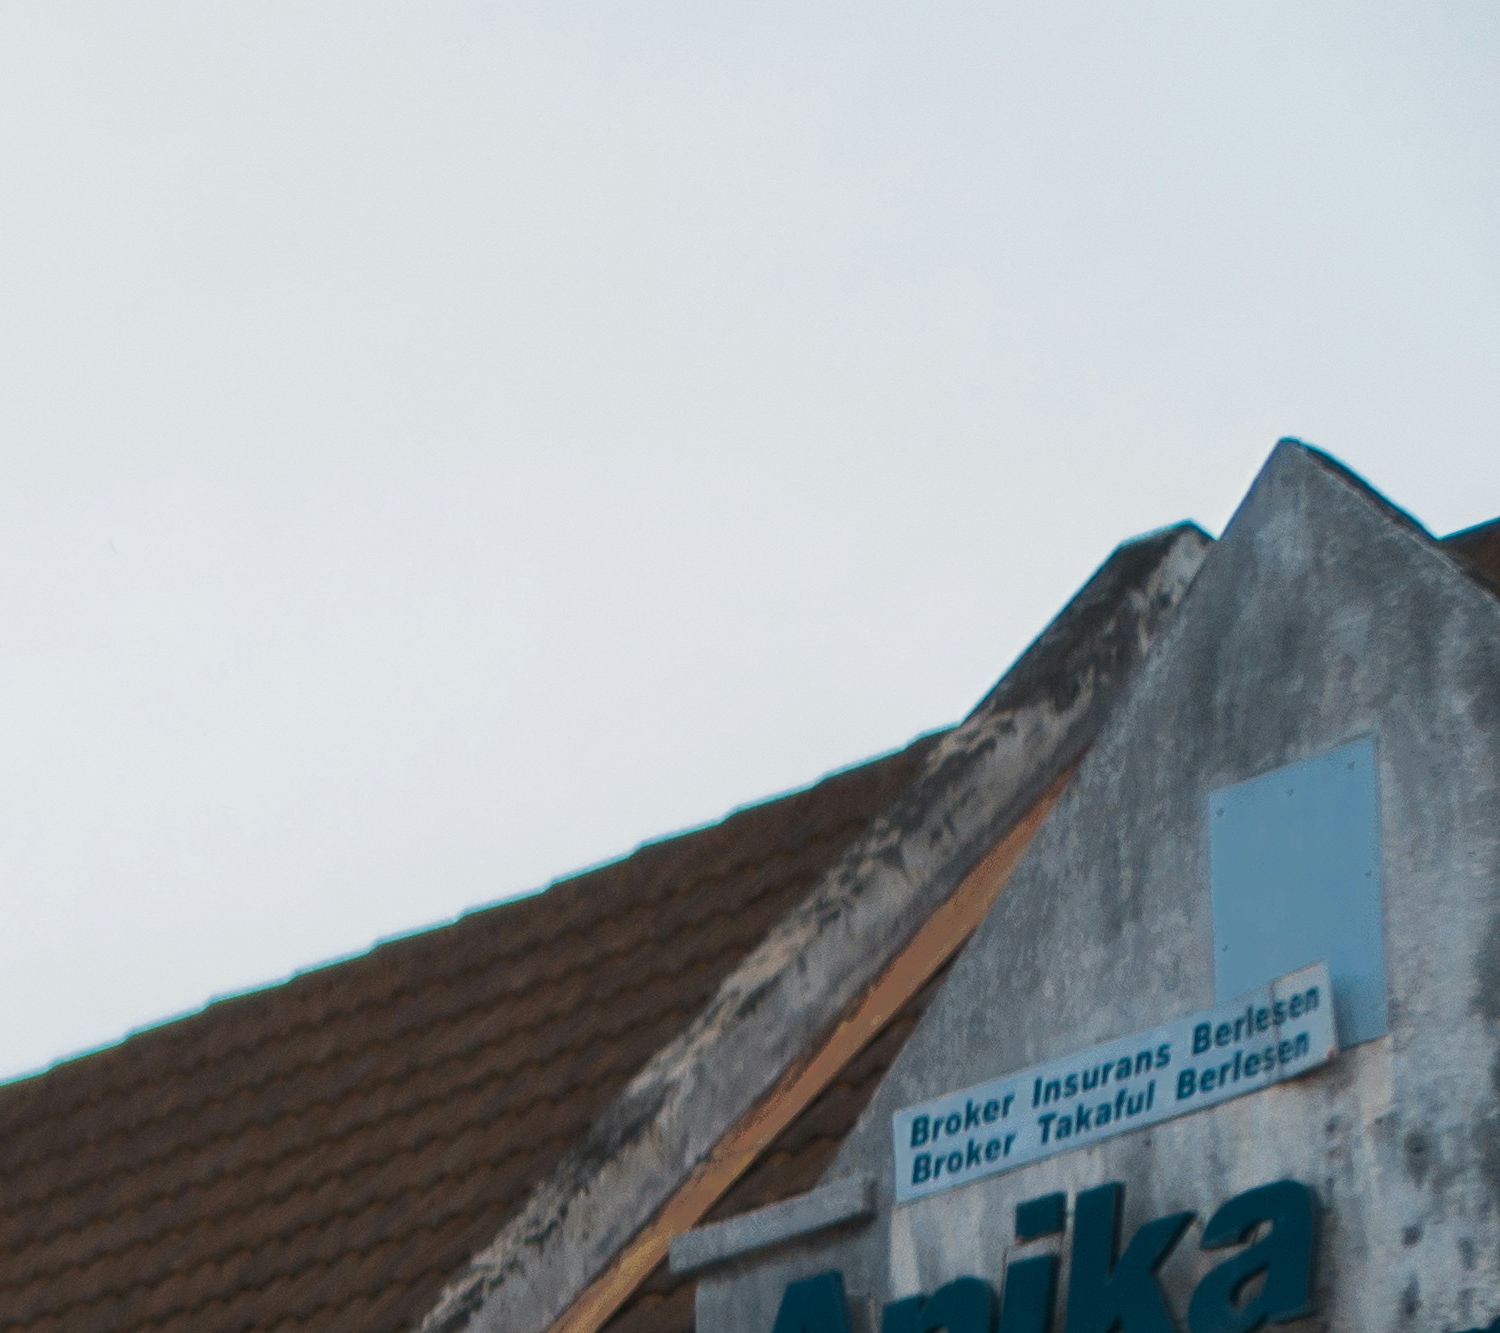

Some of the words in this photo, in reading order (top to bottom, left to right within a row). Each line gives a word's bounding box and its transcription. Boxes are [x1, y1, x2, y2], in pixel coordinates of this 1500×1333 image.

[910, 1089, 1014, 1147] Broker
[1032, 1043, 1172, 1107] Insurans
[1192, 985, 1320, 1056] Berlesen
[911, 1131, 1016, 1185] Broker
[1037, 1081, 1156, 1145] Takaful
[1176, 1031, 1309, 1099] Berlesen
